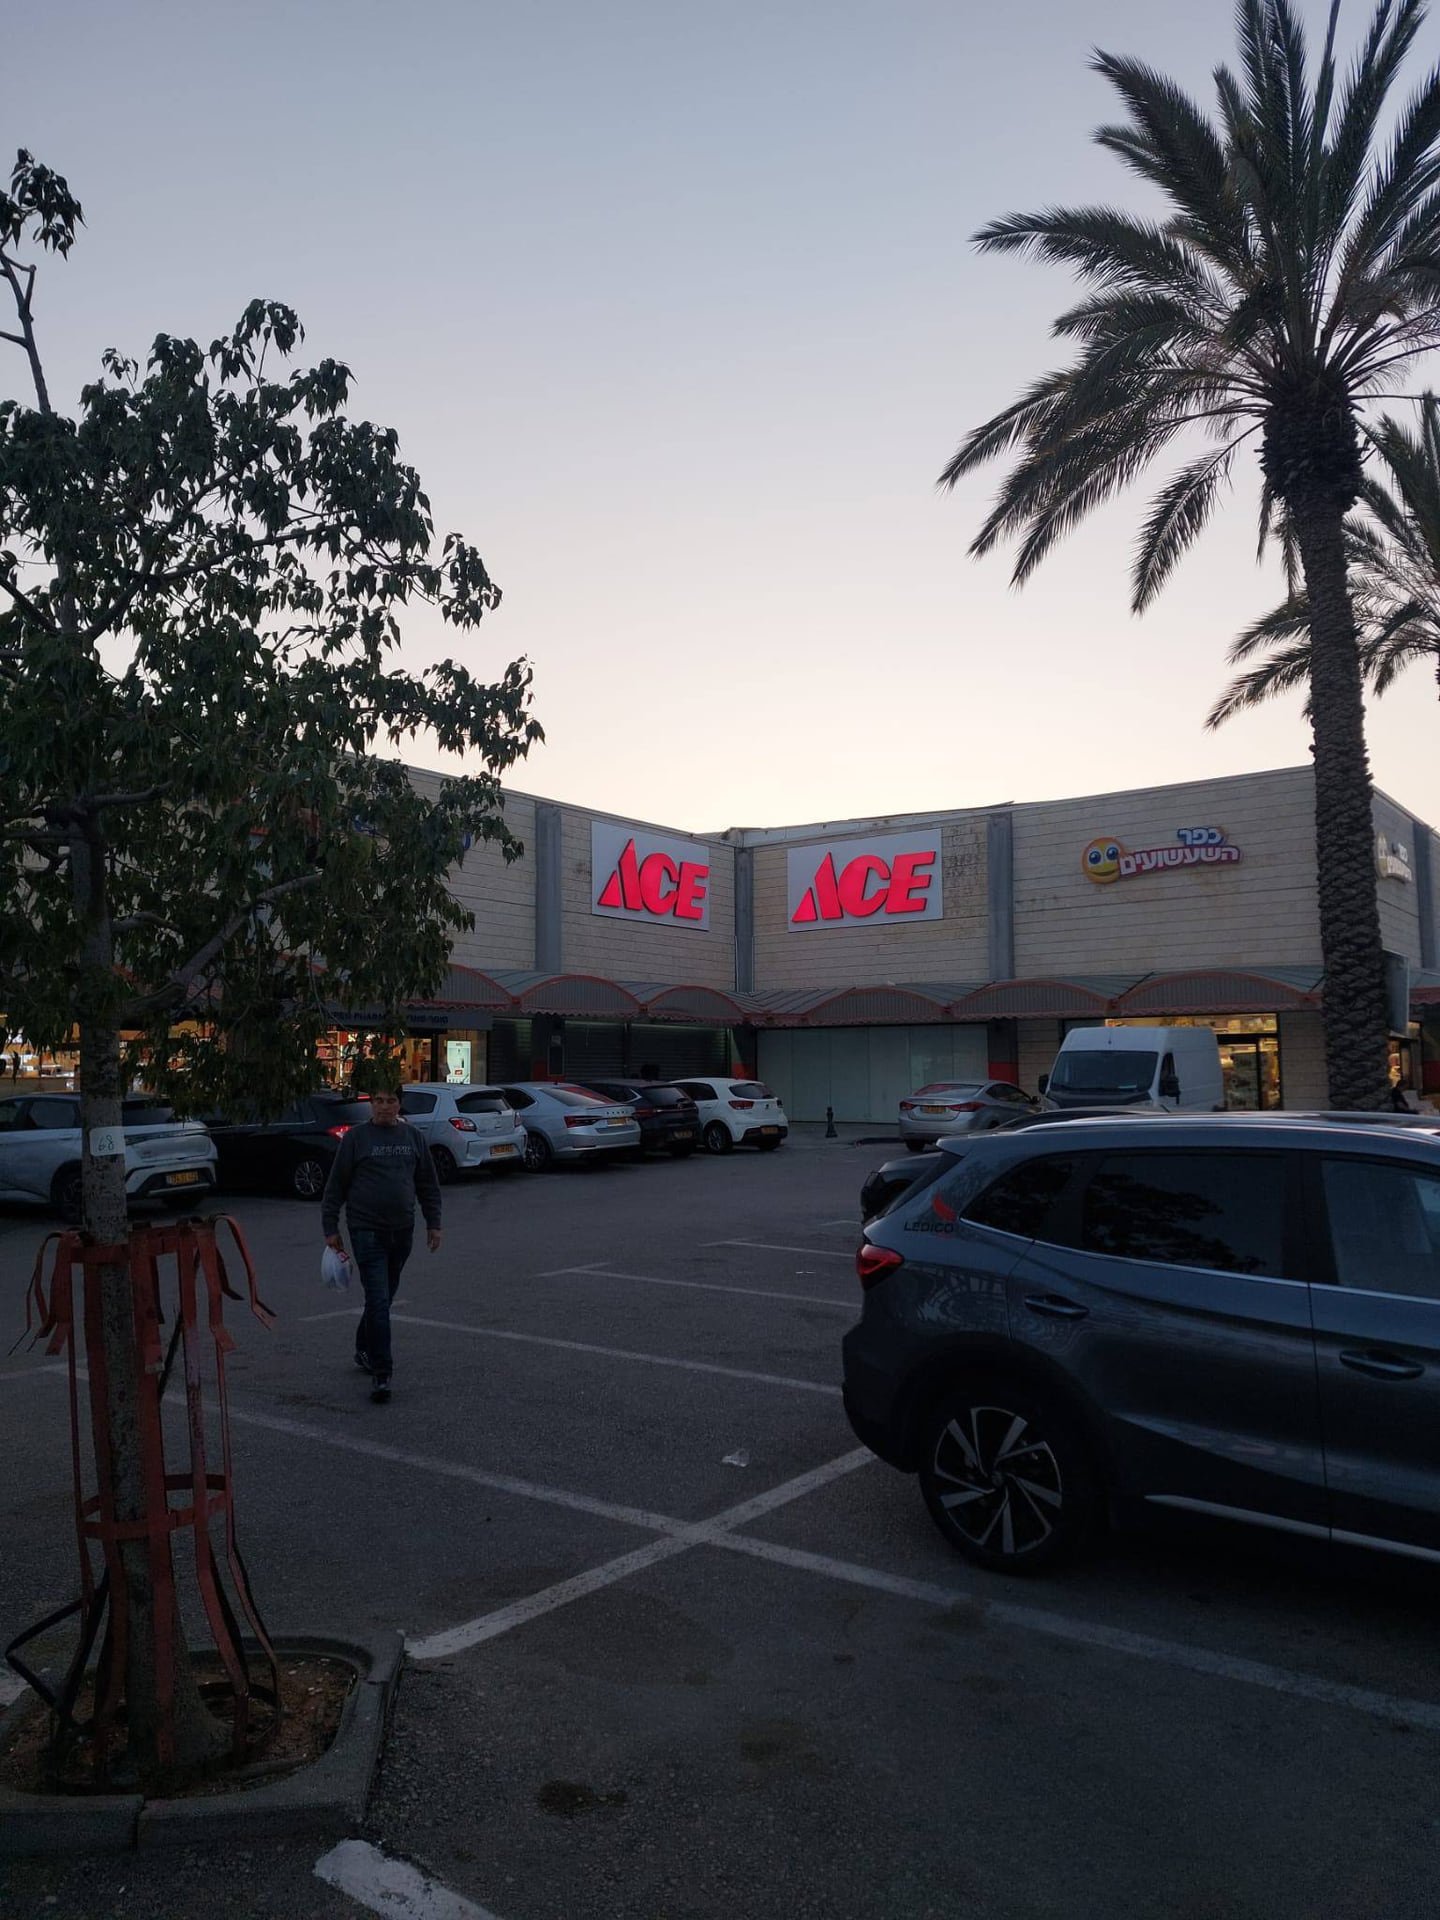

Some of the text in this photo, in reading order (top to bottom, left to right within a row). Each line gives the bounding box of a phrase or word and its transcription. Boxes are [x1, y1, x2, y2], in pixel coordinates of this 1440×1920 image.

[1178, 827, 1224, 846] כפר
[1119, 846, 1240, 876] השעשועים
[597, 838, 709, 920] ACE
[792, 850, 937, 923] ACE
[904, 1222, 954, 1232] LEDICO
